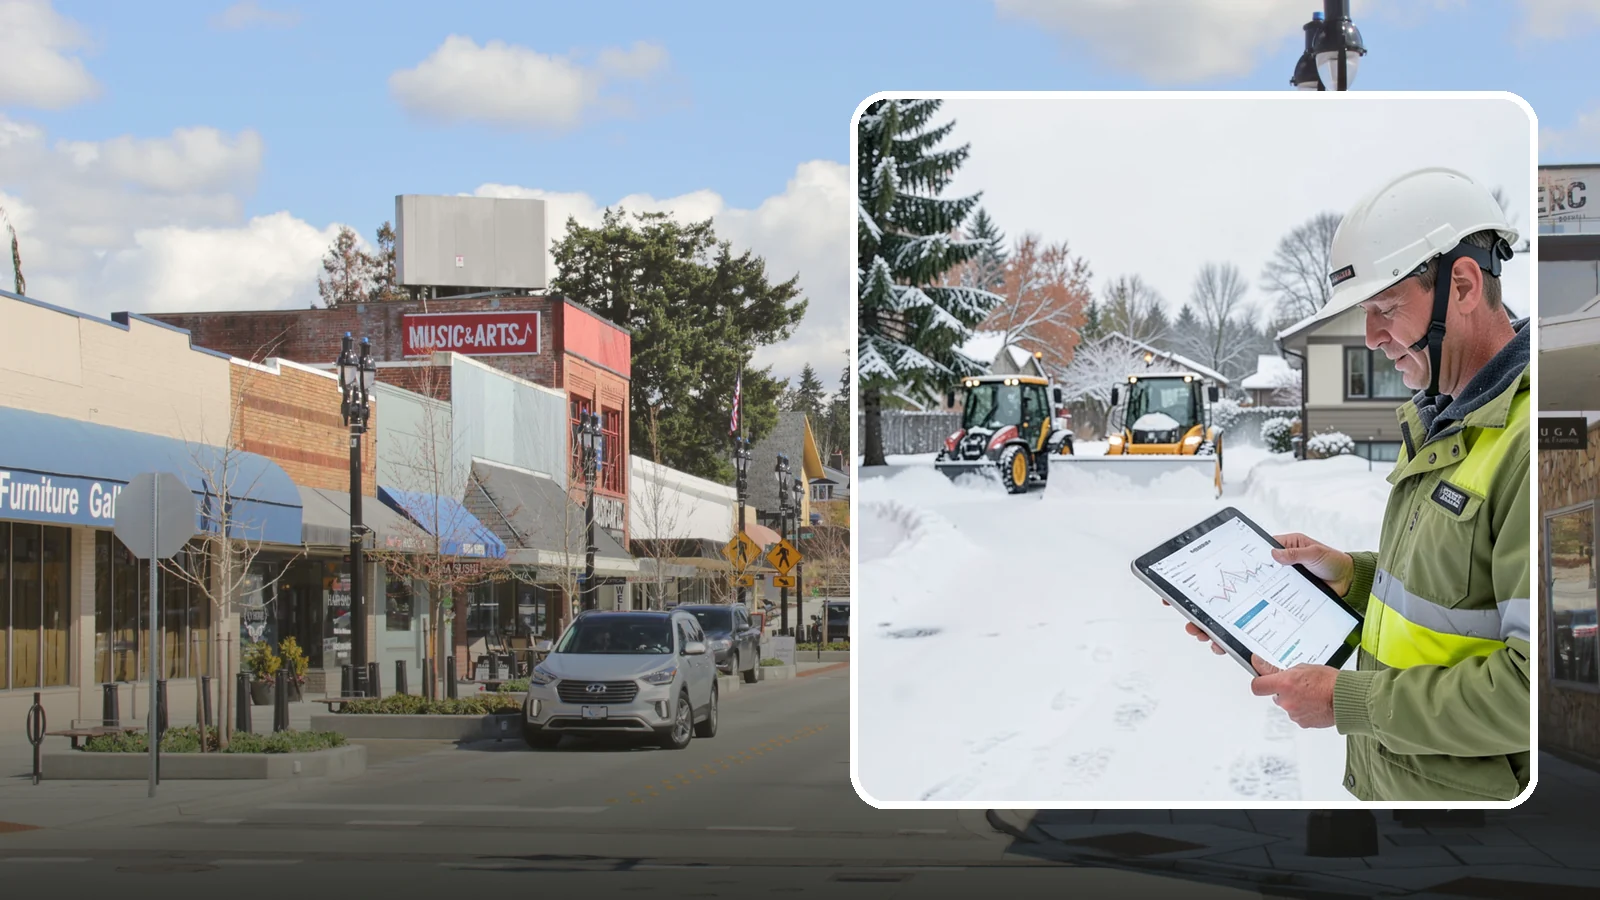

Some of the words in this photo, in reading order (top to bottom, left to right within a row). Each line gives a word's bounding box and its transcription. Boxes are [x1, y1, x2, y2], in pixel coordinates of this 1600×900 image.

[1537, 181, 1587, 213] ERC
[408, 323, 519, 349] MUSIC&ARTS
[1540, 427, 1578, 437] UGA
[0, 471, 79, 516] Furniture
[89, 482, 122, 519] Gal
